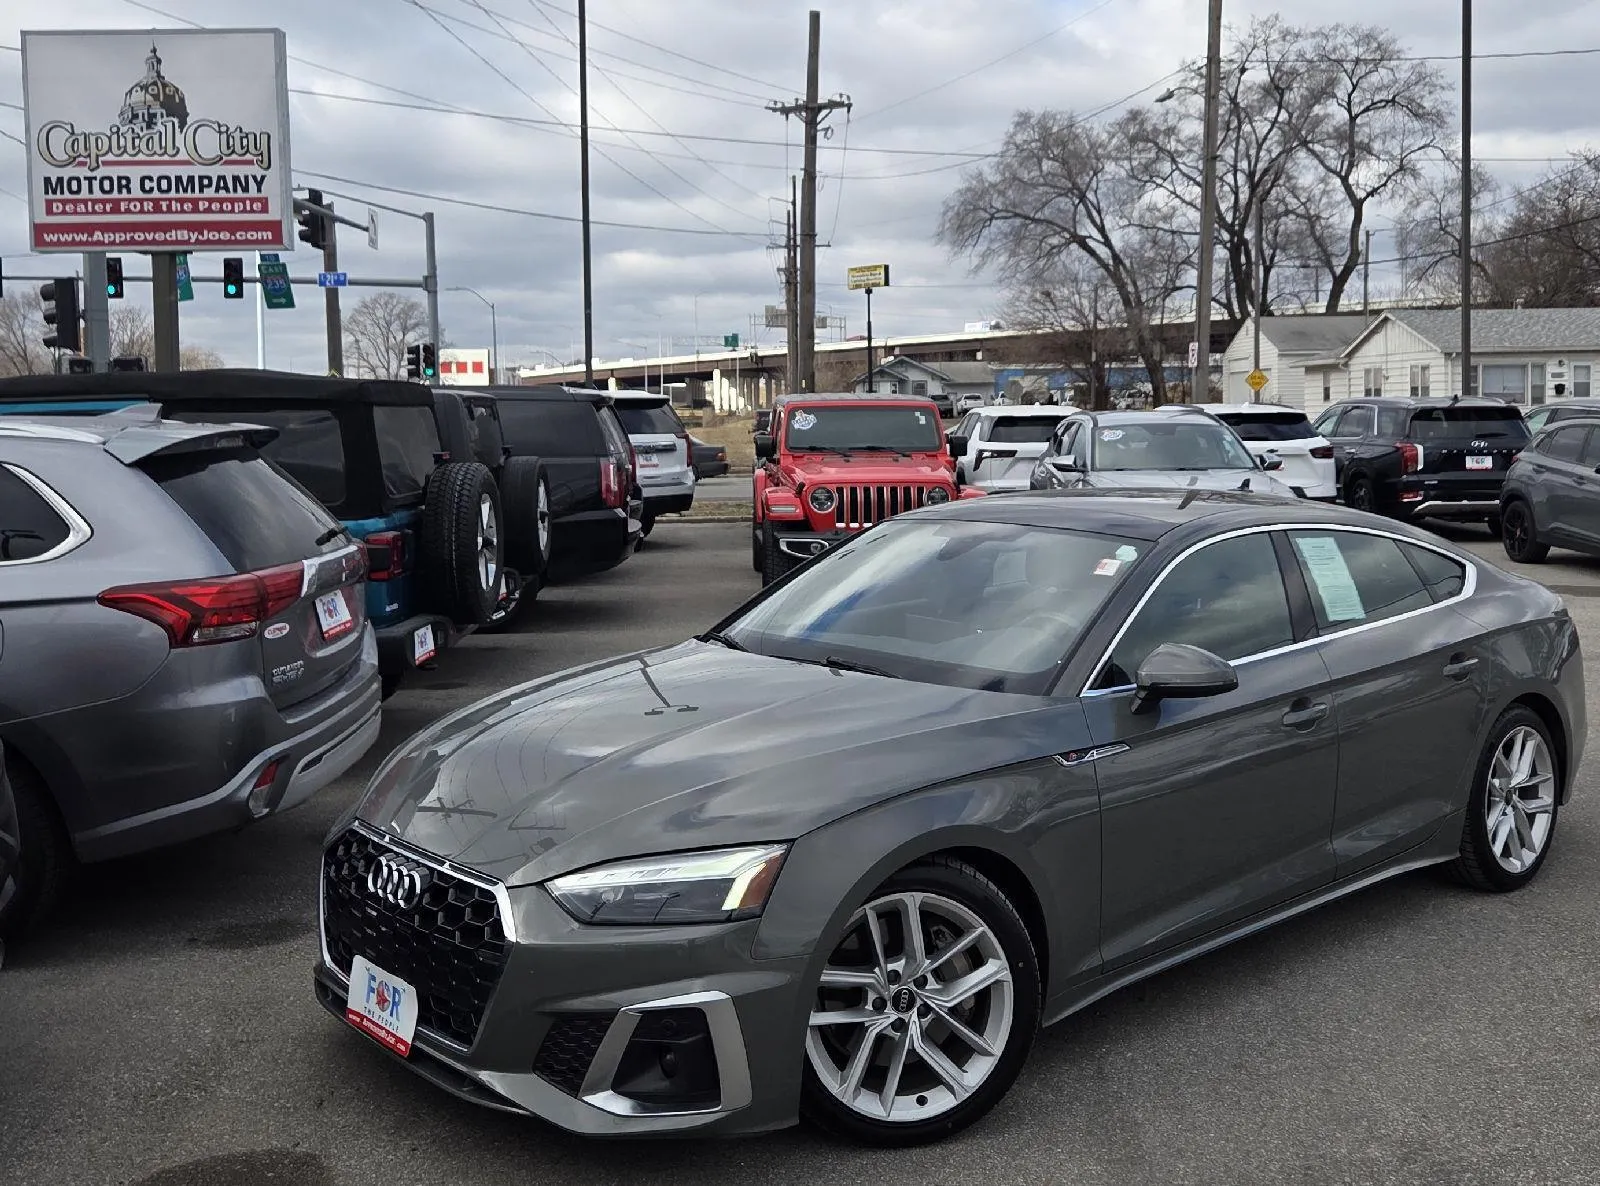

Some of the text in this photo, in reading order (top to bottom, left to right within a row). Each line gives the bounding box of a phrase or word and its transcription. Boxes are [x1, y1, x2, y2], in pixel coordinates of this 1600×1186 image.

[37, 118, 272, 172] Capital City
[43, 174, 267, 196] MOTOR COMPANY
[52, 199, 264, 213] Dealer FOR The People
[43, 229, 273, 245] www.ApprovedByJoe.com
[365, 972, 403, 1021] FOR
[363, 1006, 400, 1032] THE PEOPLE
